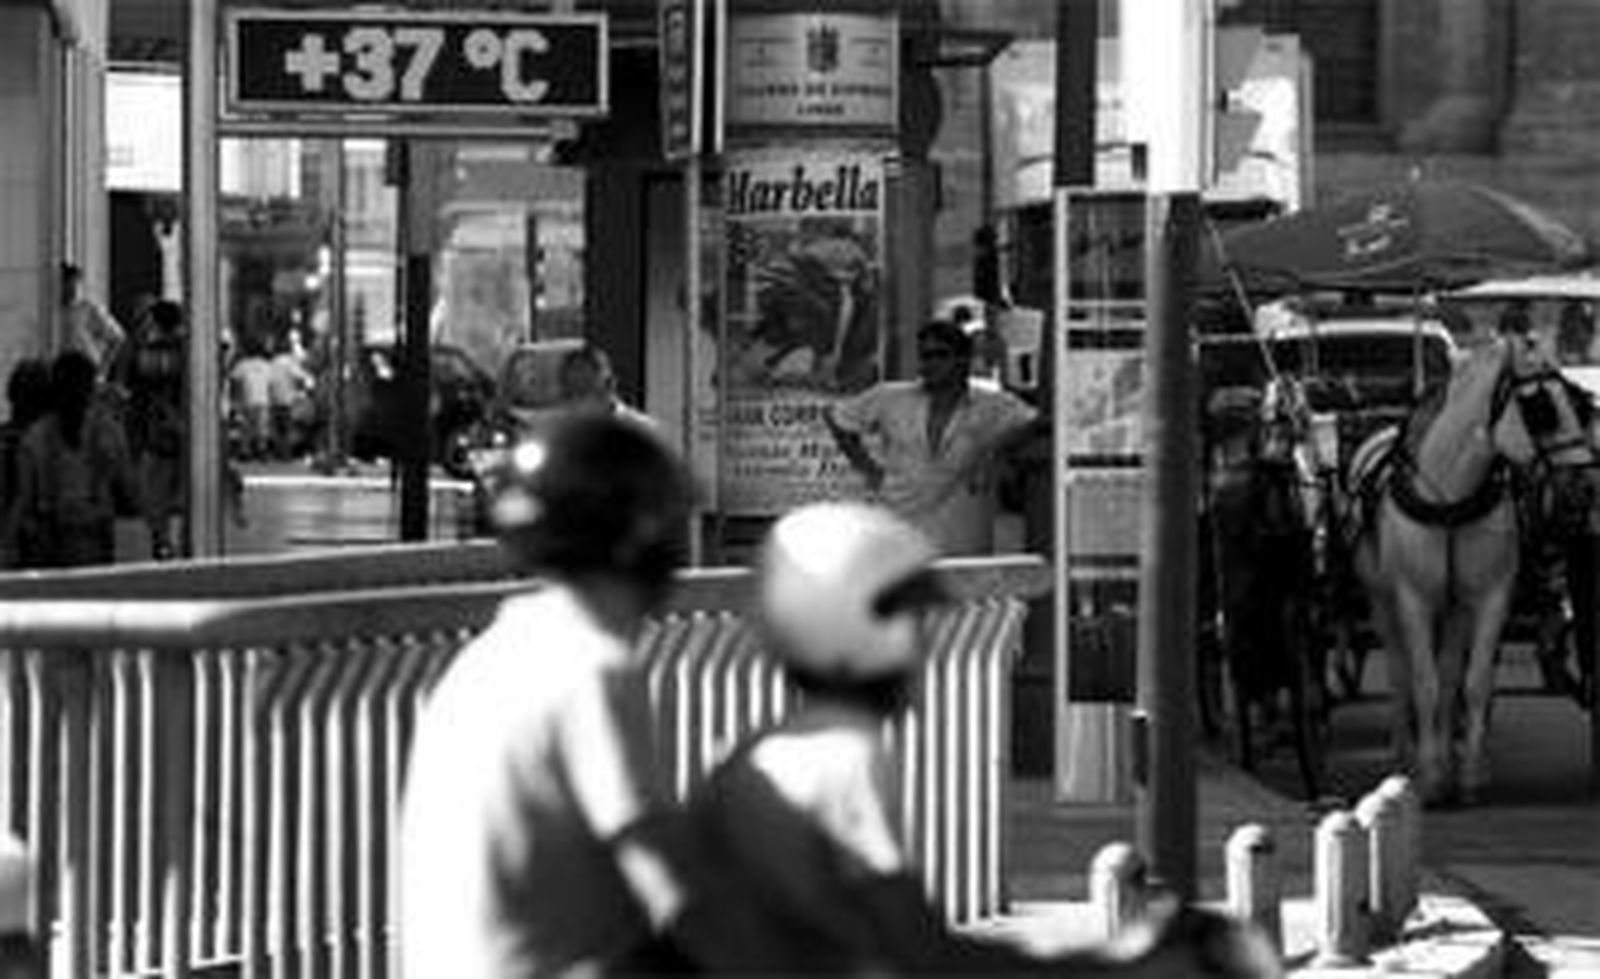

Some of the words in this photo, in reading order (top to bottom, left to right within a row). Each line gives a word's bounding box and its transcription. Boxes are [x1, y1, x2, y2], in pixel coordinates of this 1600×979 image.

[285, 27, 445, 101] +37
[463, 28, 549, 102] °C
[726, 165, 879, 215] Marbella
